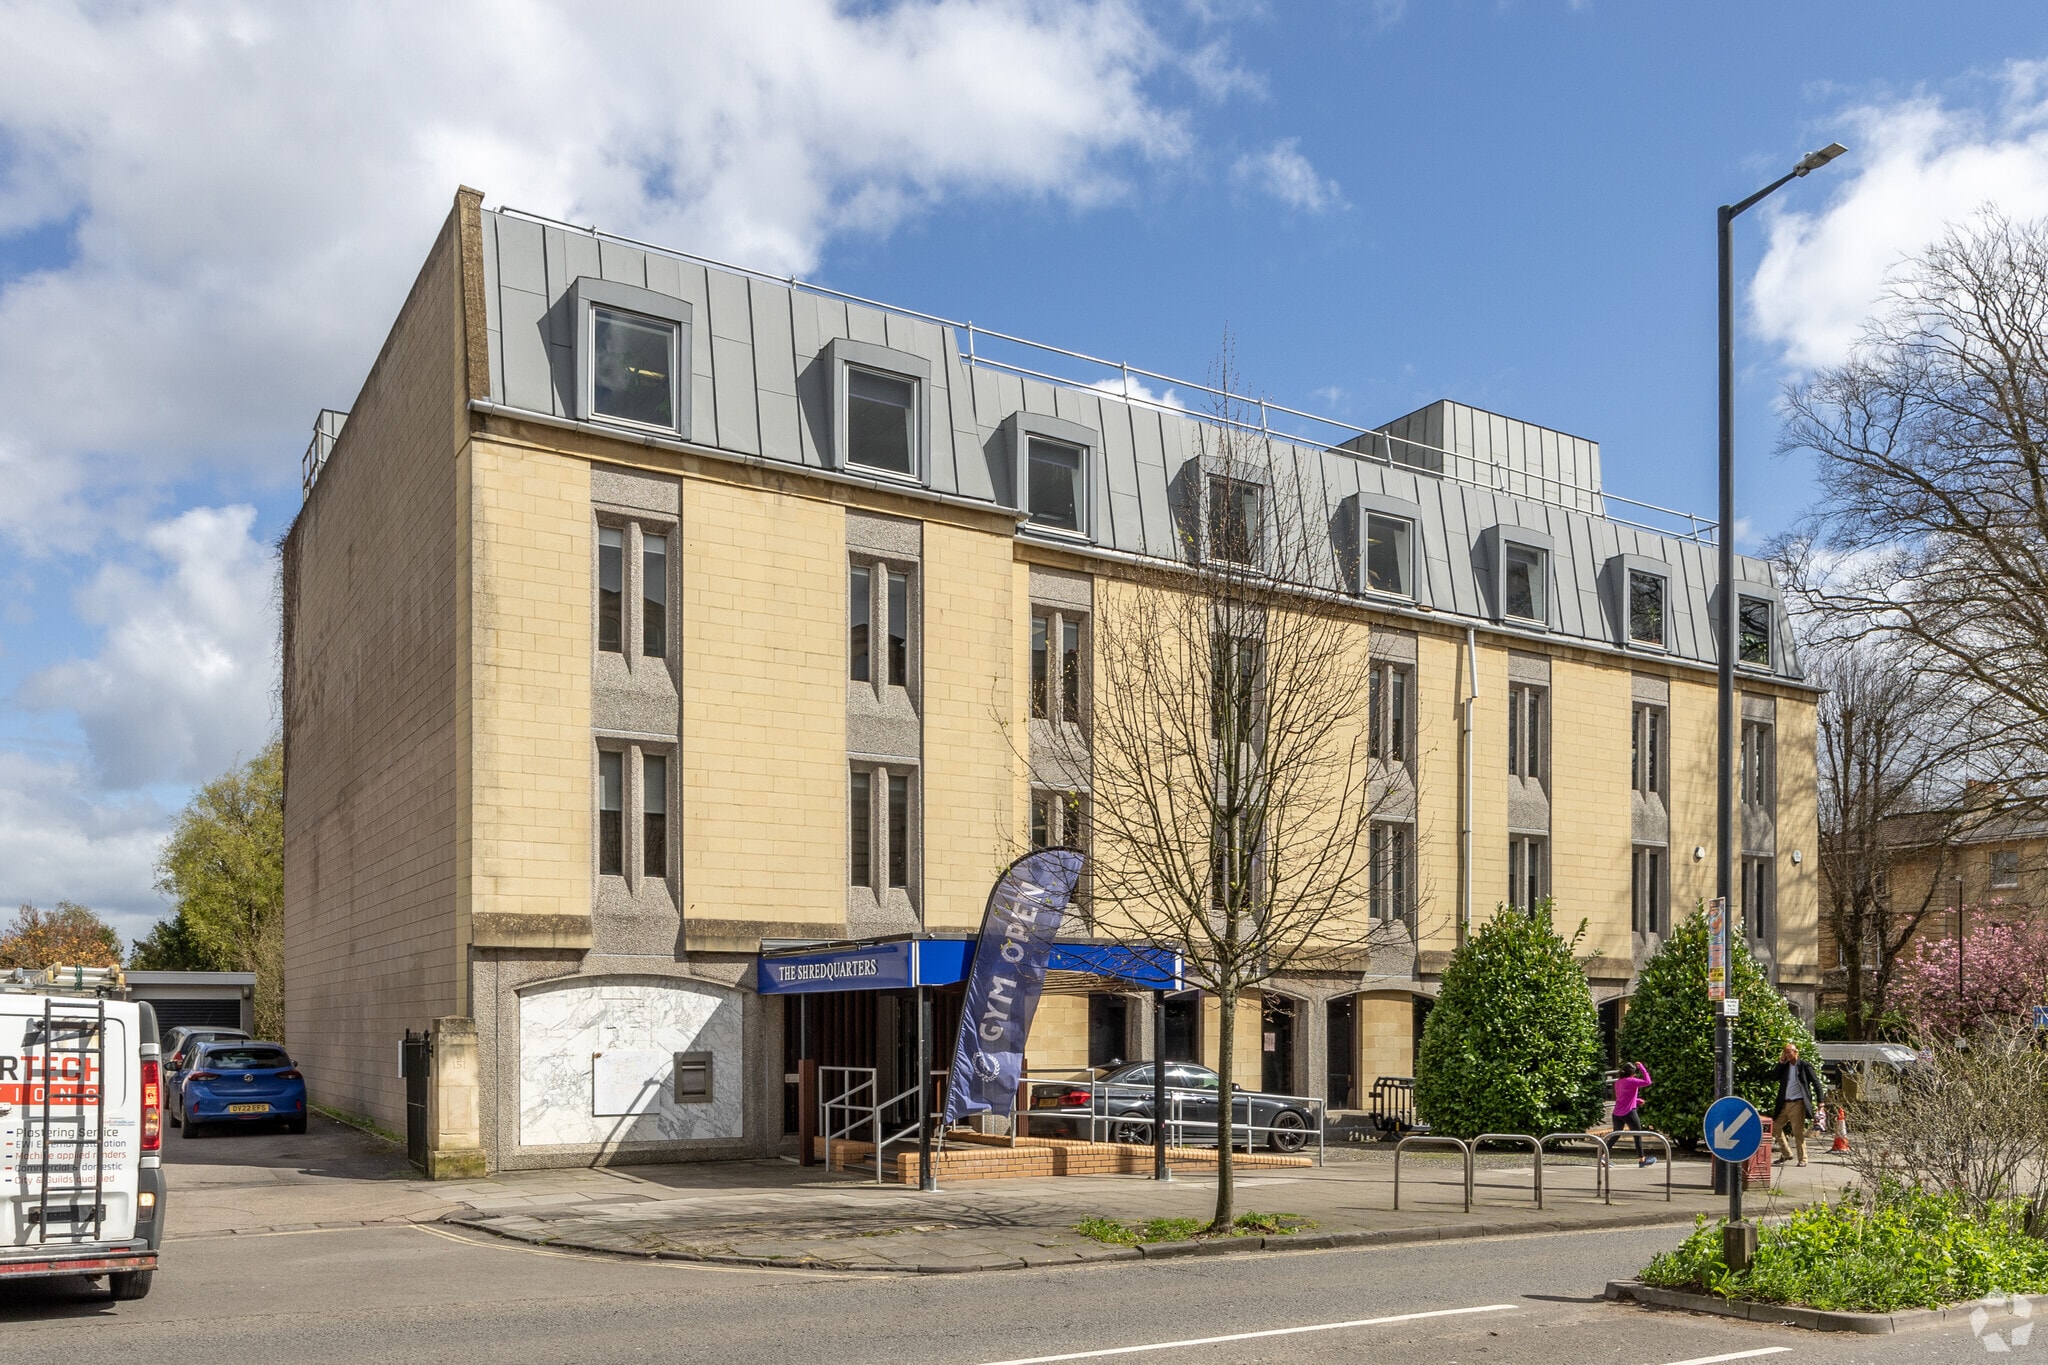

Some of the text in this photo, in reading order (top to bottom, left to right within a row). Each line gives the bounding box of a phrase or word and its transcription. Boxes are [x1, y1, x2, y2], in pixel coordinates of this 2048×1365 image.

[979, 881, 1045, 1042] GYM OPEN
[779, 959, 877, 981] THE SHREDQUARTERS
[452, 1060, 466, 1070] 151
[78, 1127, 119, 1137] Serice
[93, 1149, 127, 1159] rnders
